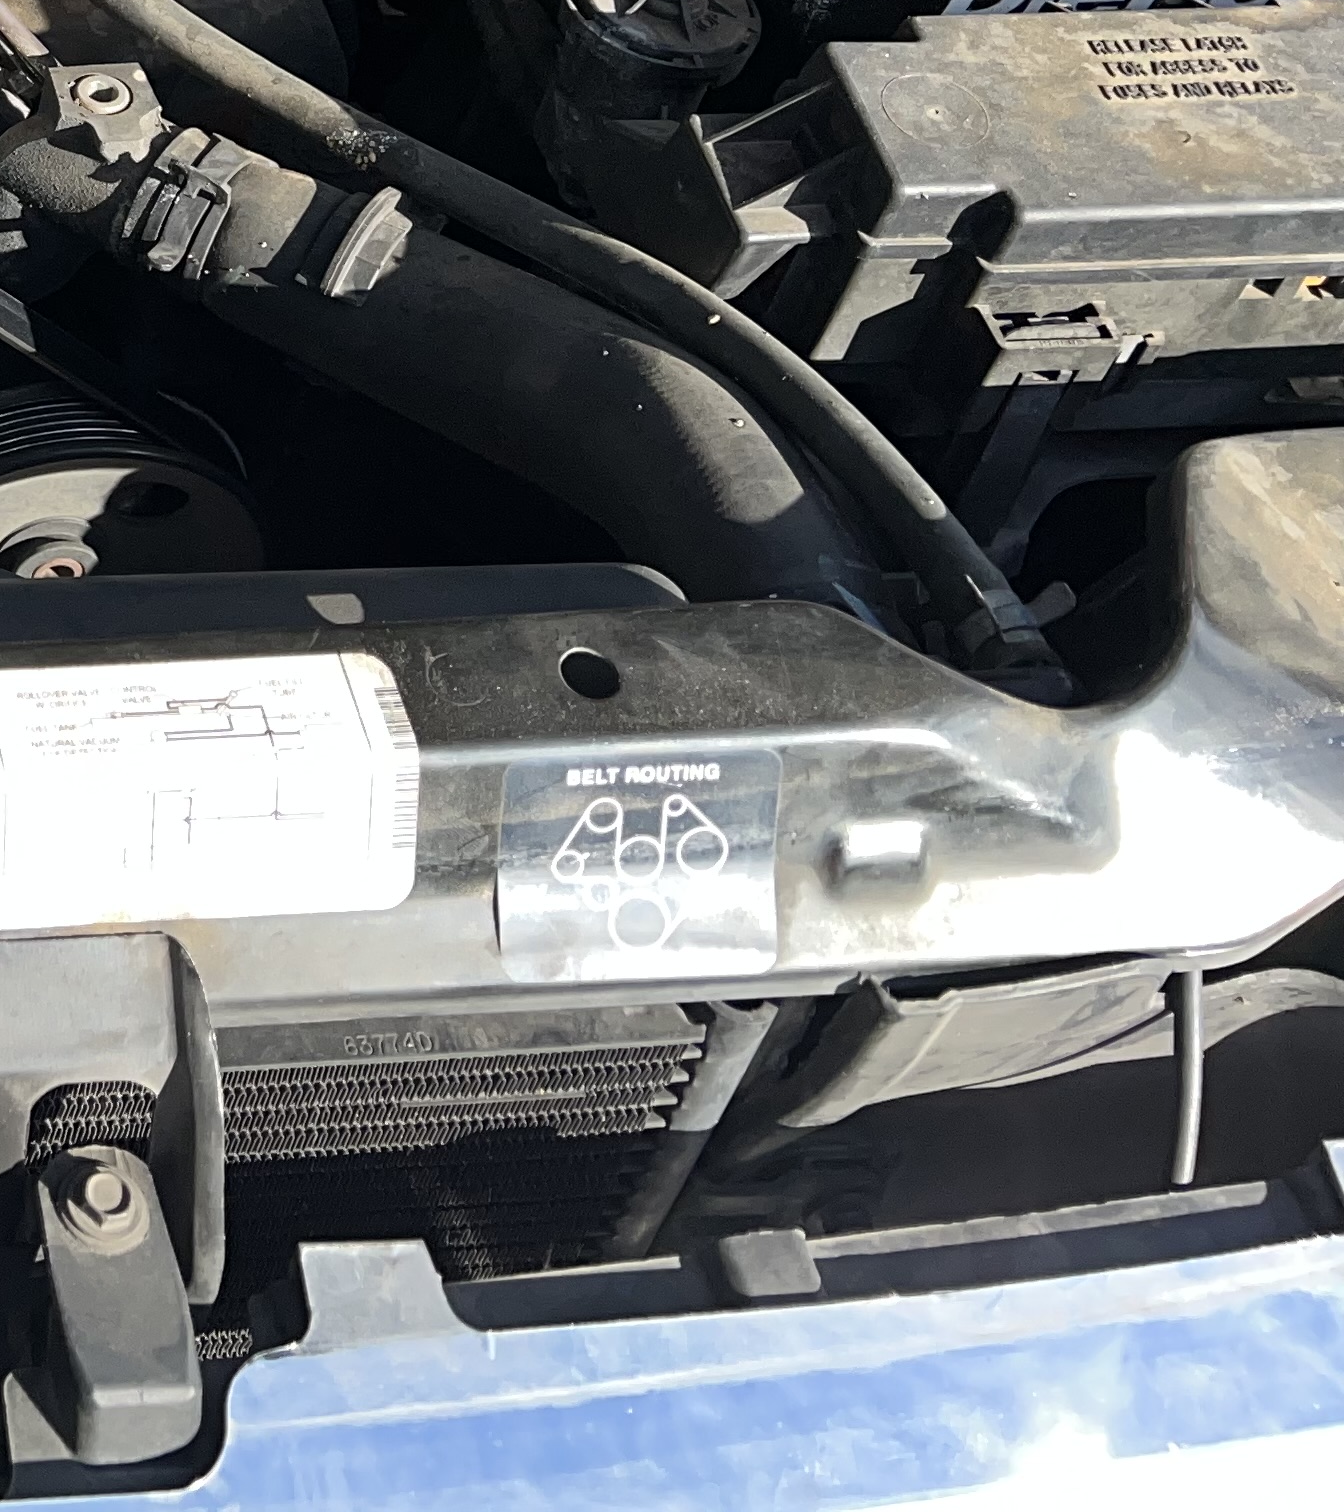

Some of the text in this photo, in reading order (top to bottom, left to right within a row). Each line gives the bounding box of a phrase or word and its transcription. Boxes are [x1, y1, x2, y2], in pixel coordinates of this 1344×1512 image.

[1086, 39, 1178, 56] RELEASE
[1102, 56, 1261, 78] FOR ACCESS TO
[1097, 78, 1296, 101] FUSES AND RELAYS
[567, 763, 721, 786] BELT ROUTING
